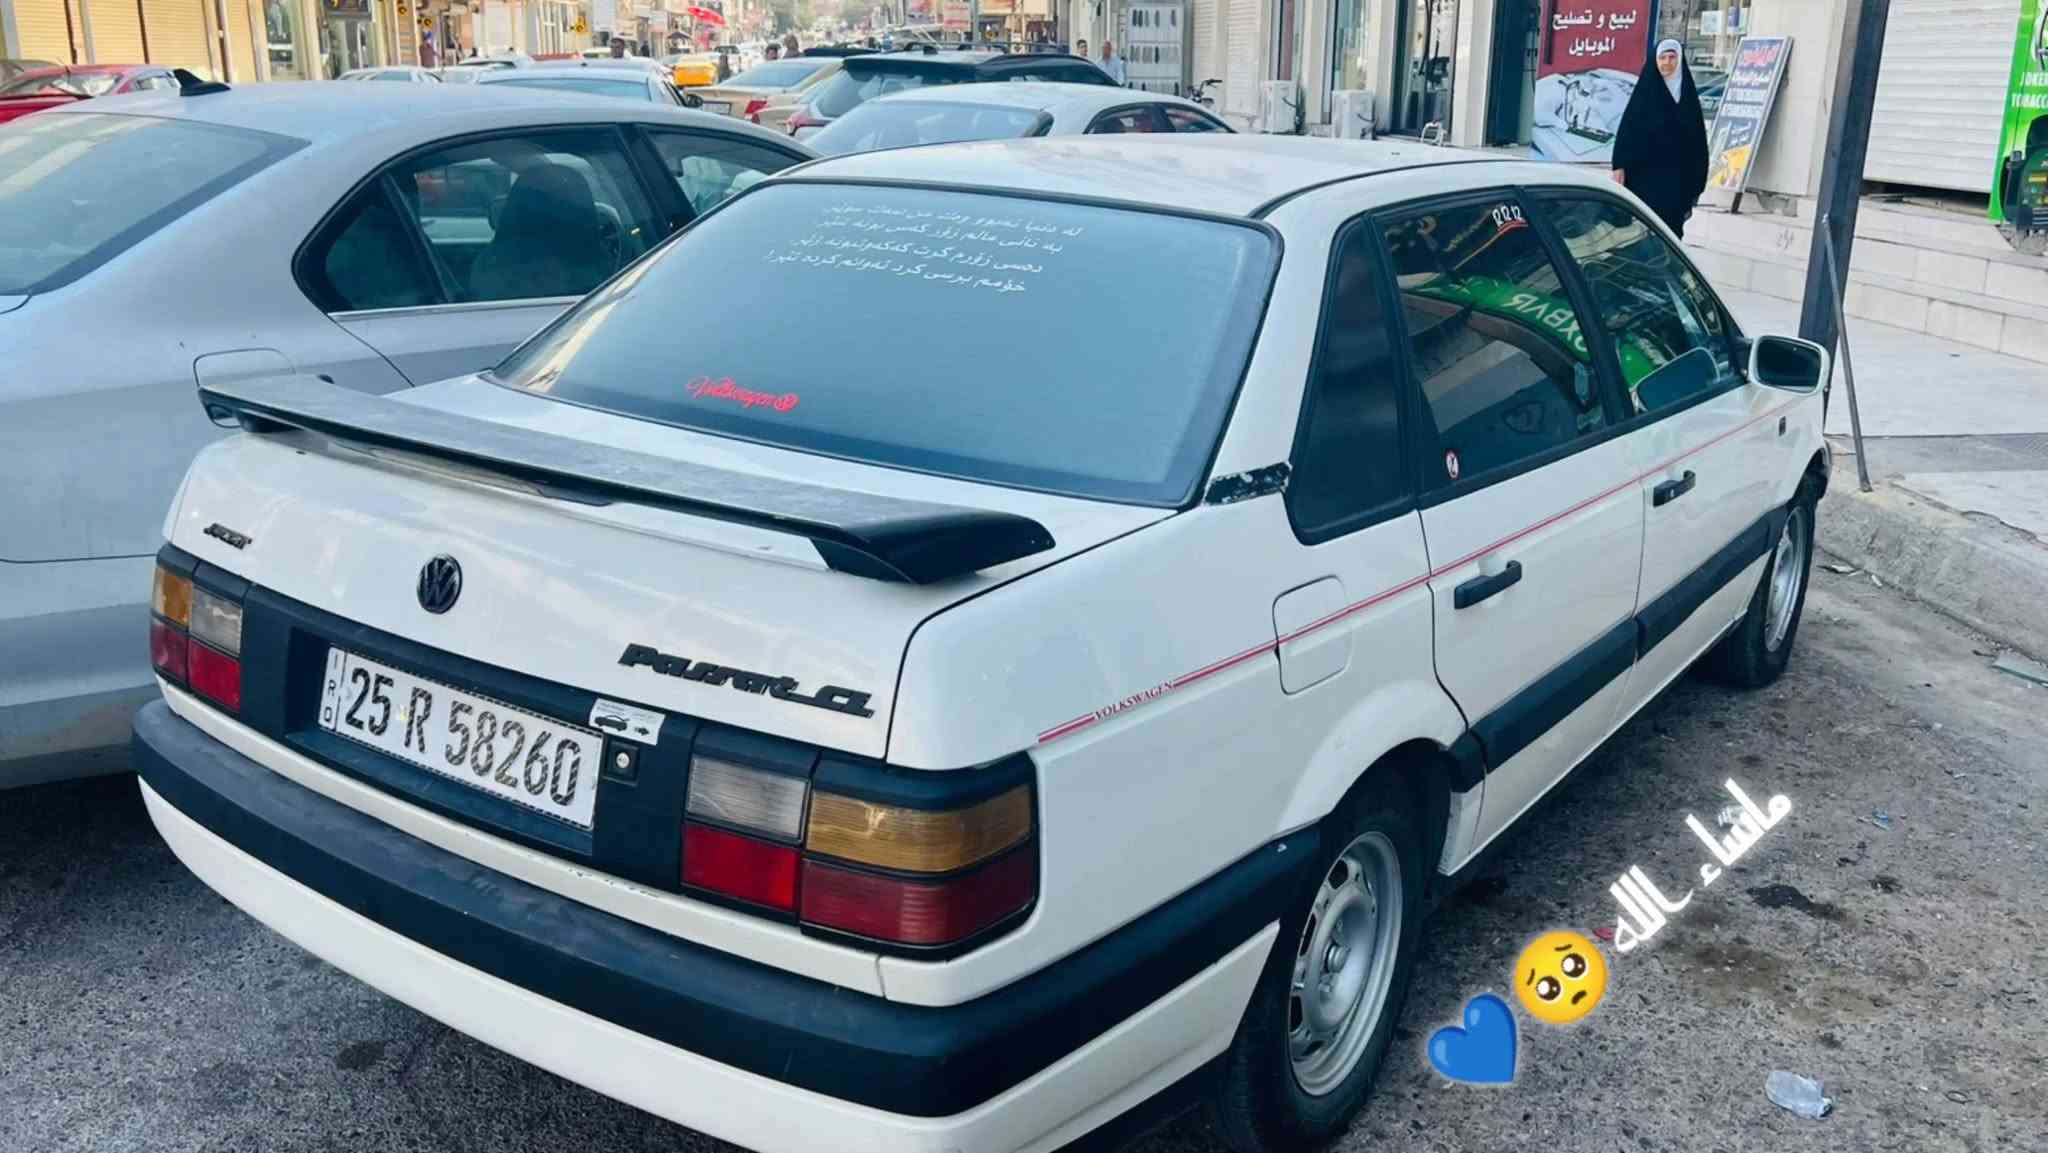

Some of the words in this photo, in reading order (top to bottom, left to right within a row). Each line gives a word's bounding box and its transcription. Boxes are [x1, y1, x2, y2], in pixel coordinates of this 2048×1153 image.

[1552, 9, 1592, 30] تصليح
[1595, 13, 1605, 28] و
[1608, 9, 1637, 30] لبيع
[1568, 36, 1616, 56] الموبايل
[1094, 681, 1173, 721] VOLKSWAGEN
[345, 667, 394, 736] 25
[404, 686, 432, 753] R
[444, 699, 581, 806] 58260
